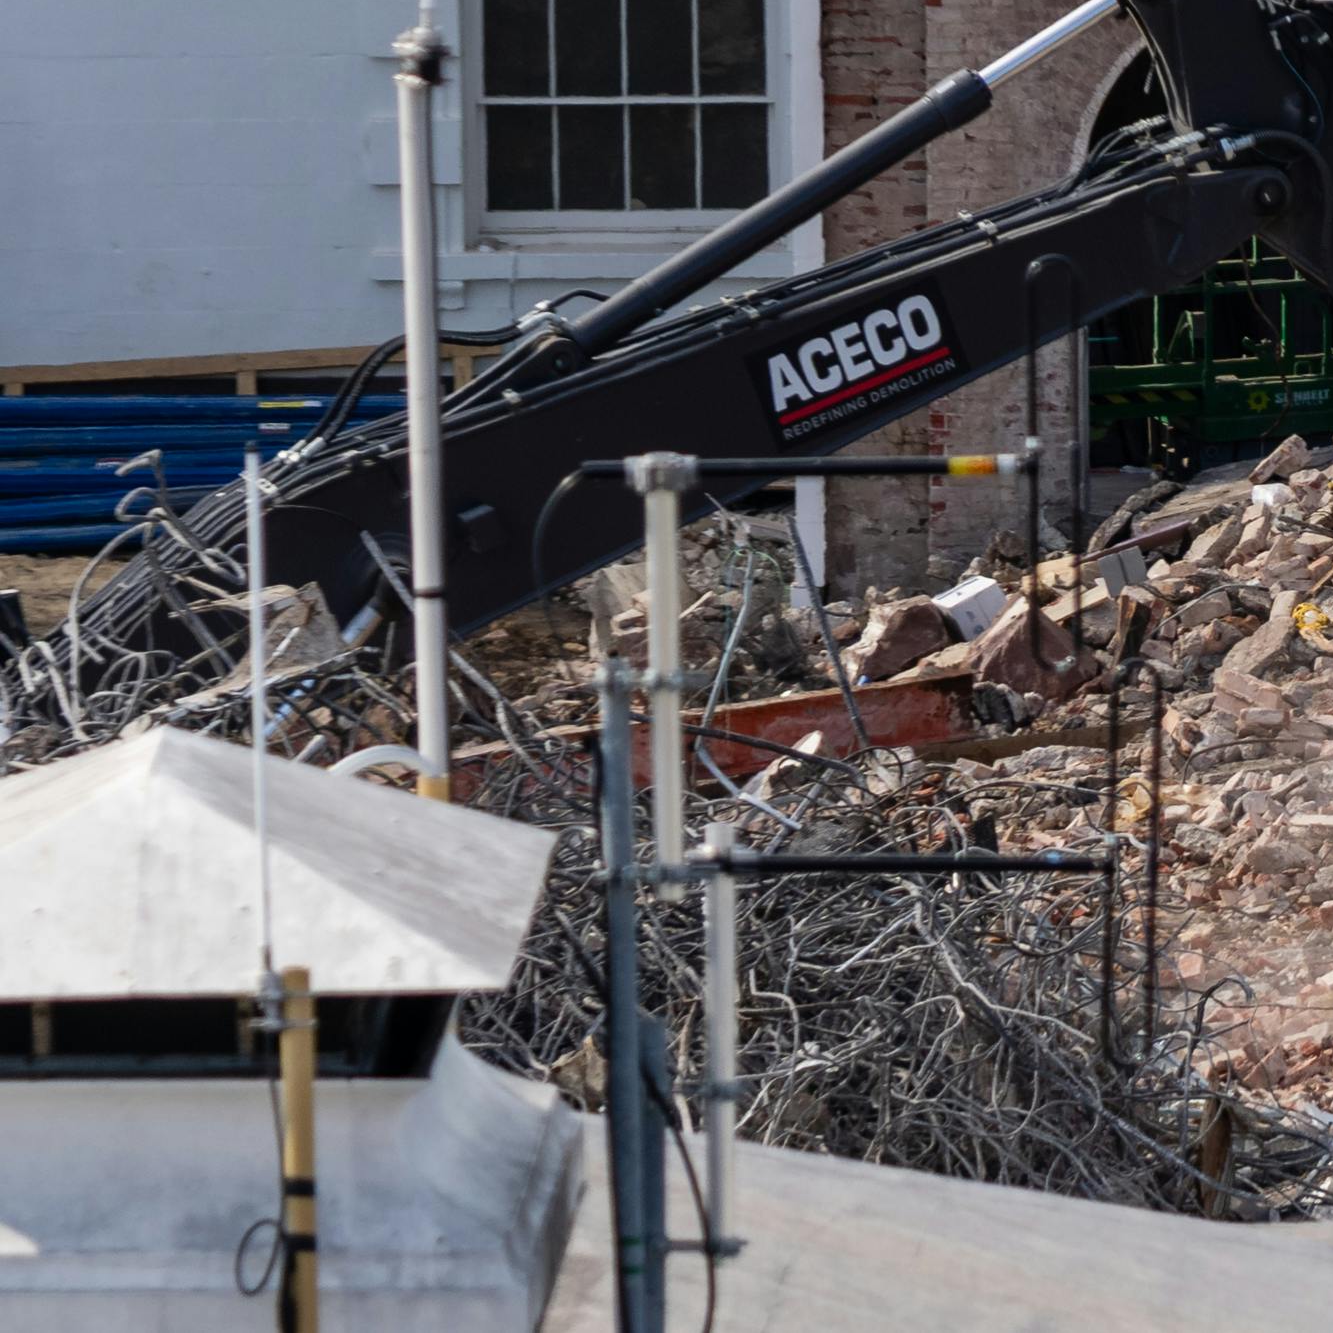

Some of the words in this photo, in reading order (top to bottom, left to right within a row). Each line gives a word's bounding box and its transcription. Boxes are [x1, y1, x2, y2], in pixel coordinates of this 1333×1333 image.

[767, 294, 942, 412] ACECO
[782, 396, 868, 440] REDEFINING
[870, 357, 957, 403] DEMOLITION
